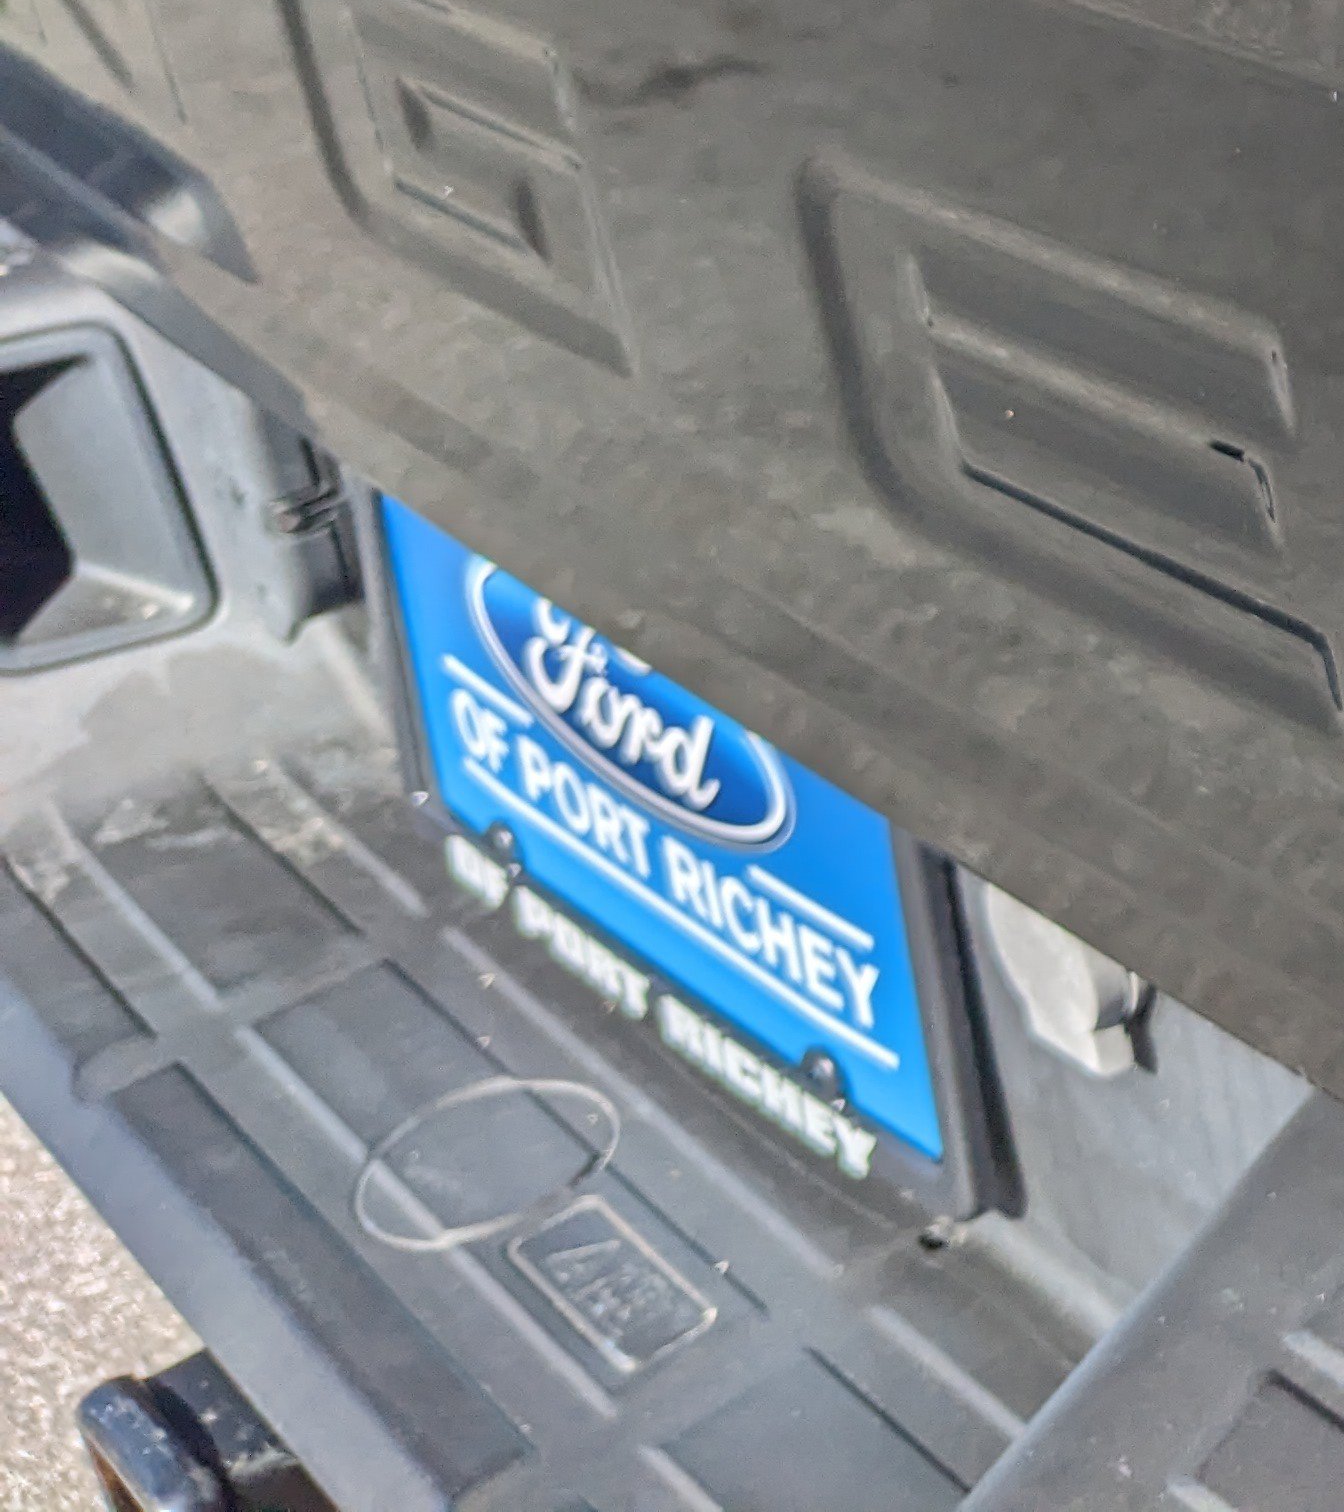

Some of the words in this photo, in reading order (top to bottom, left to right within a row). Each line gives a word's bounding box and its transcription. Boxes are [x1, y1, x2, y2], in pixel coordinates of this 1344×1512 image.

[449, 687, 510, 772] OF
[517, 734, 653, 878] PORT
[660, 834, 880, 1029] RICHEY
[523, 596, 721, 810] Ford
[445, 833, 512, 909] OF
[513, 883, 651, 1022] PORT
[657, 993, 878, 1180] RICHEY
